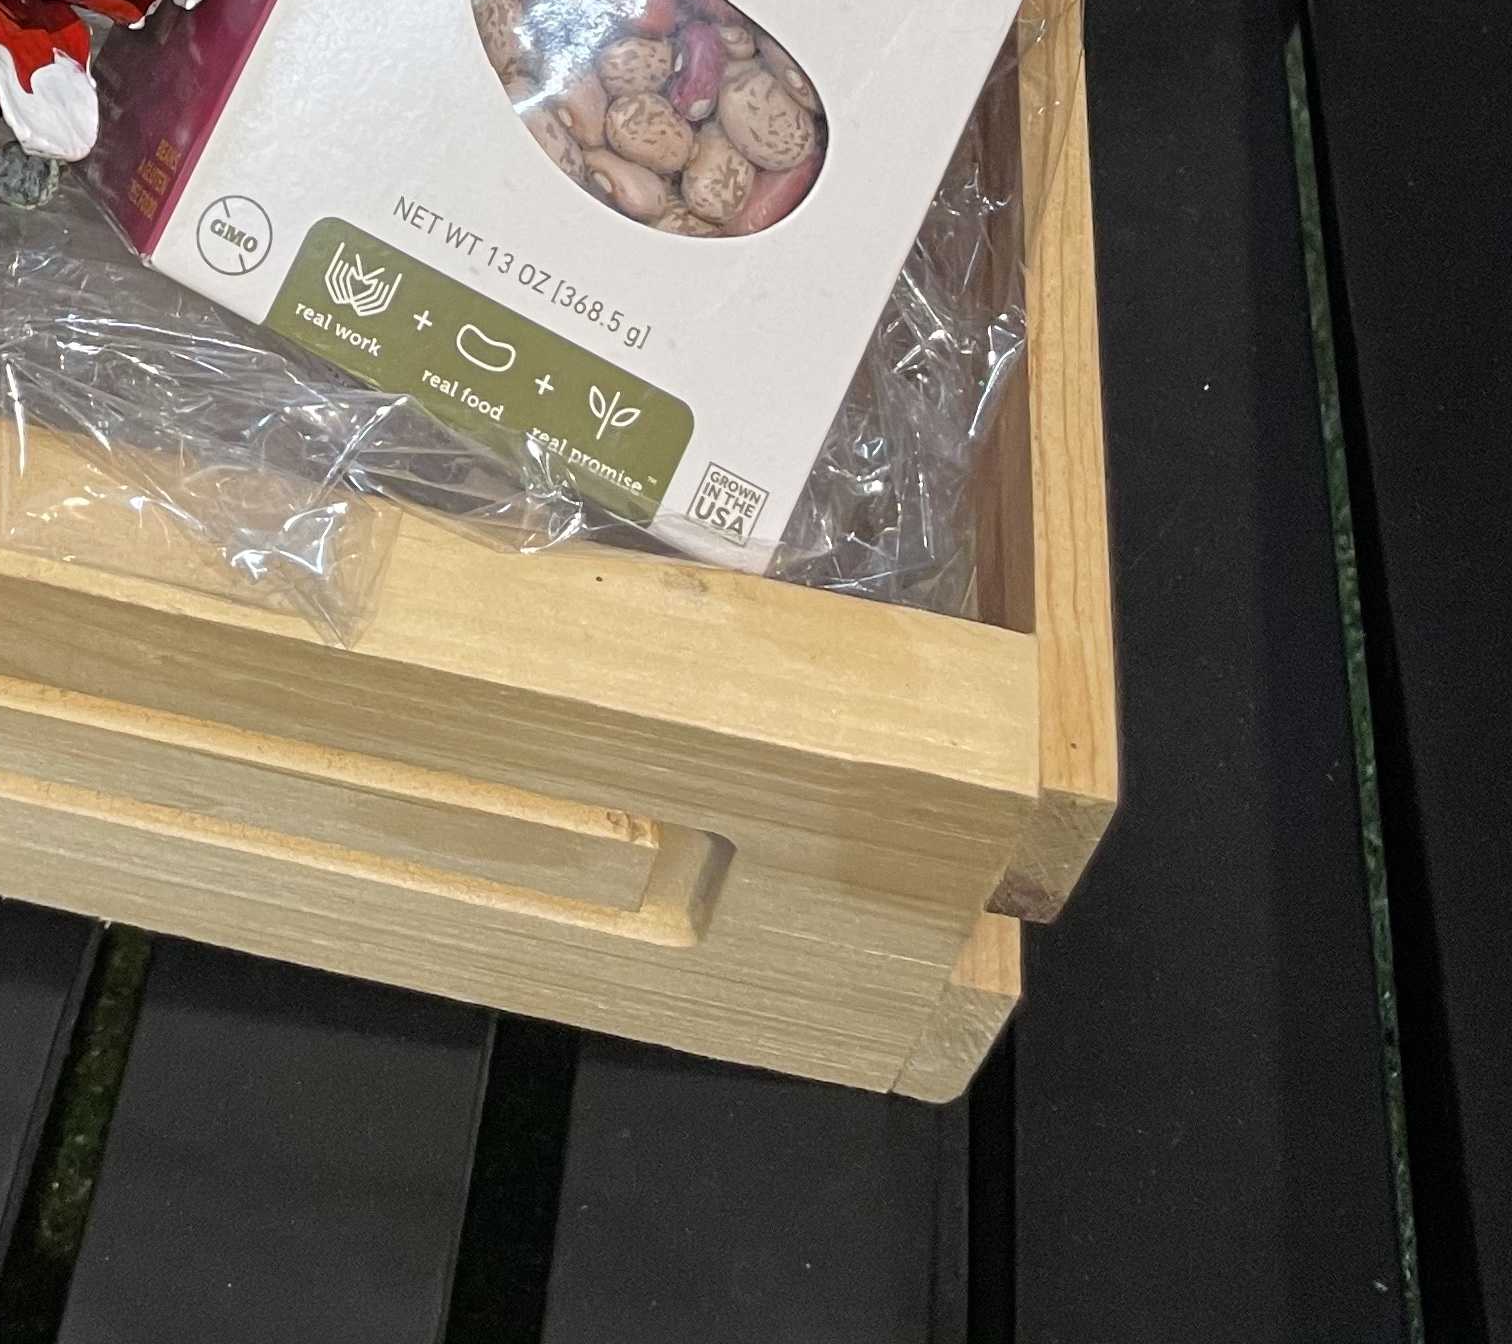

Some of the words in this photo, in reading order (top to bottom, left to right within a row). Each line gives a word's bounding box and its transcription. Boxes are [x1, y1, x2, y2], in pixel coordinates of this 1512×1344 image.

[209, 217, 258, 253] GMO
[392, 194, 444, 235] NET
[444, 221, 484, 256] WT
[486, 245, 515, 274] 13
[517, 262, 552, 295] OZ
[294, 302, 333, 330] real
[334, 322, 382, 357] work
[420, 368, 459, 397] real
[459, 386, 504, 421] food
[527, 426, 568, 456] real
[566, 446, 643, 497] promise
[702, 480, 718, 499] IN
[723, 490, 757, 519] THE
[711, 472, 762, 503] GROWN
[694, 499, 744, 539] USA
